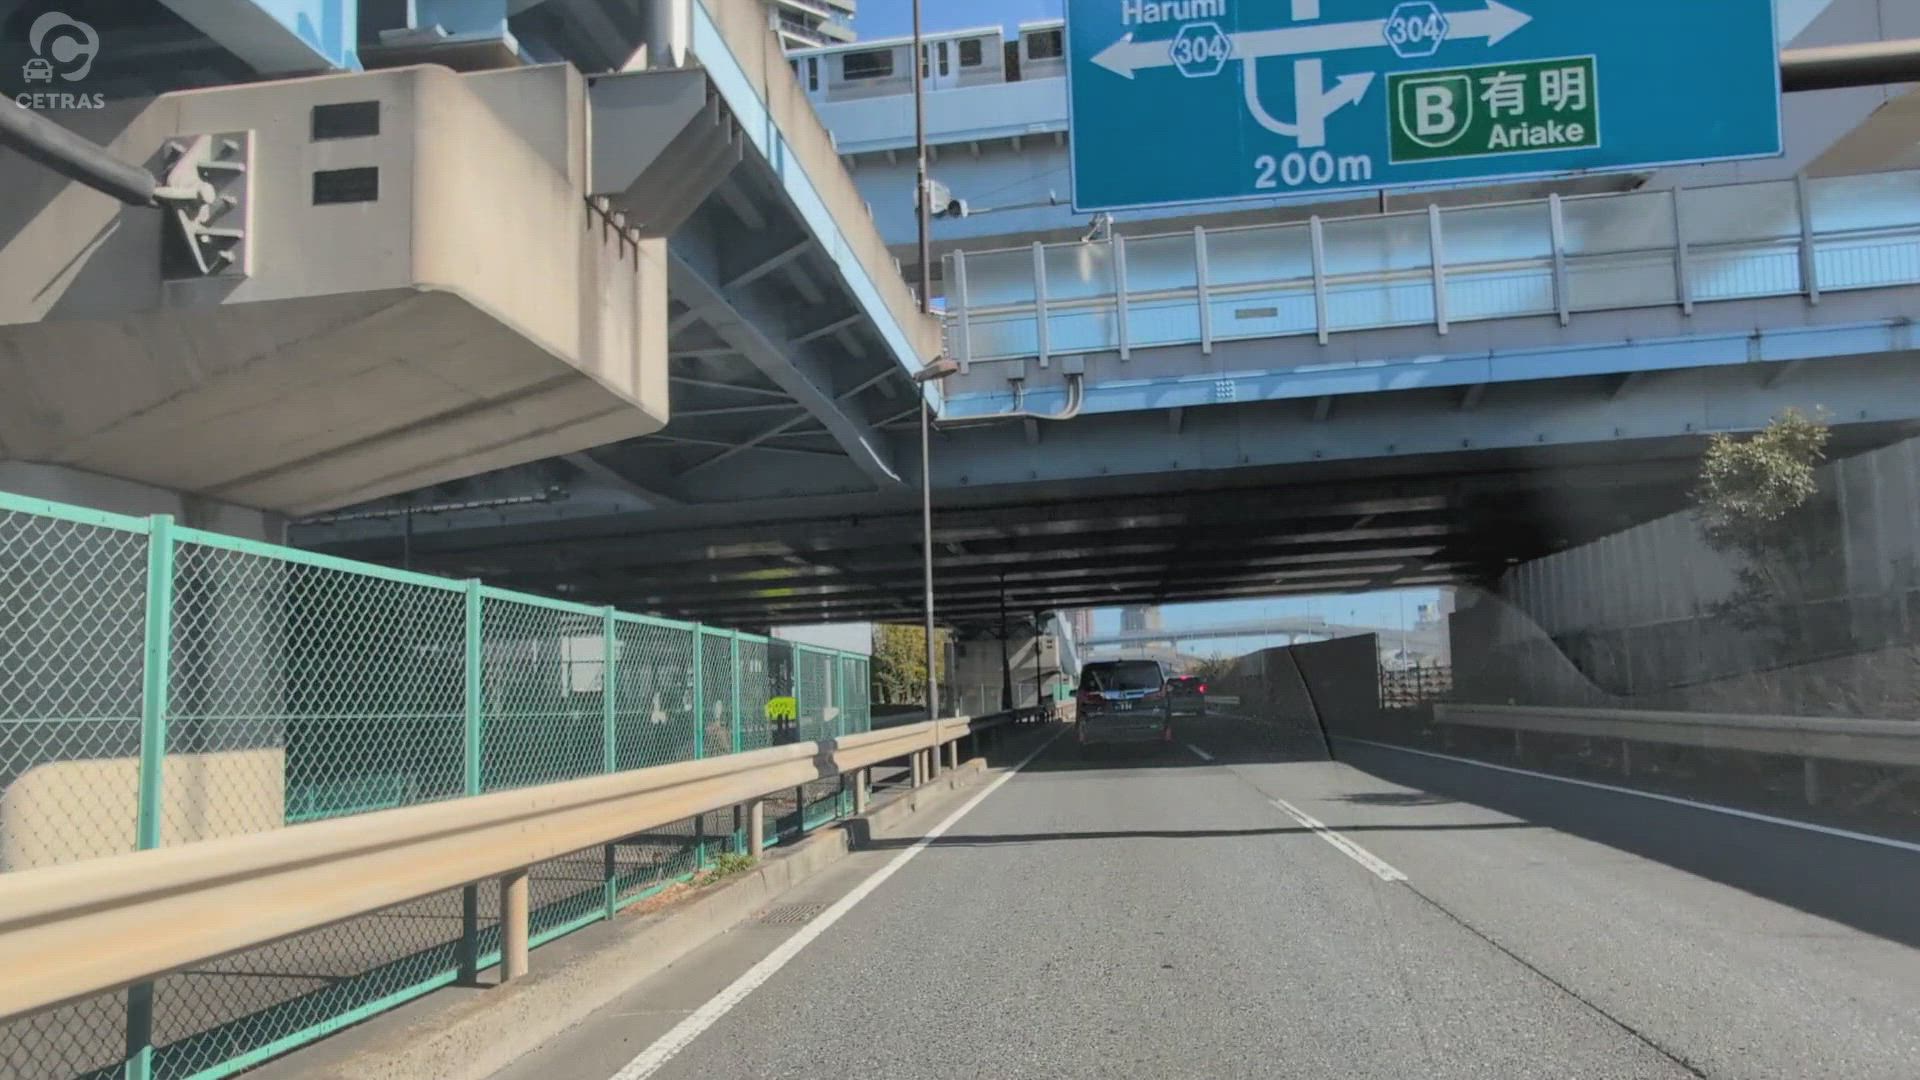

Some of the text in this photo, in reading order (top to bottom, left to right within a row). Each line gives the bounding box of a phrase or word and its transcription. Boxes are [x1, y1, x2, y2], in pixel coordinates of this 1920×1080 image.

[1121, 0, 1226, 25] Harumi
[1391, 13, 1440, 44] 304
[1176, 36, 1224, 65] 304
[1479, 66, 1587, 119] 有明
[1415, 85, 1456, 136] B
[1487, 119, 1585, 149] Ariake
[1254, 150, 1372, 189] 200m
